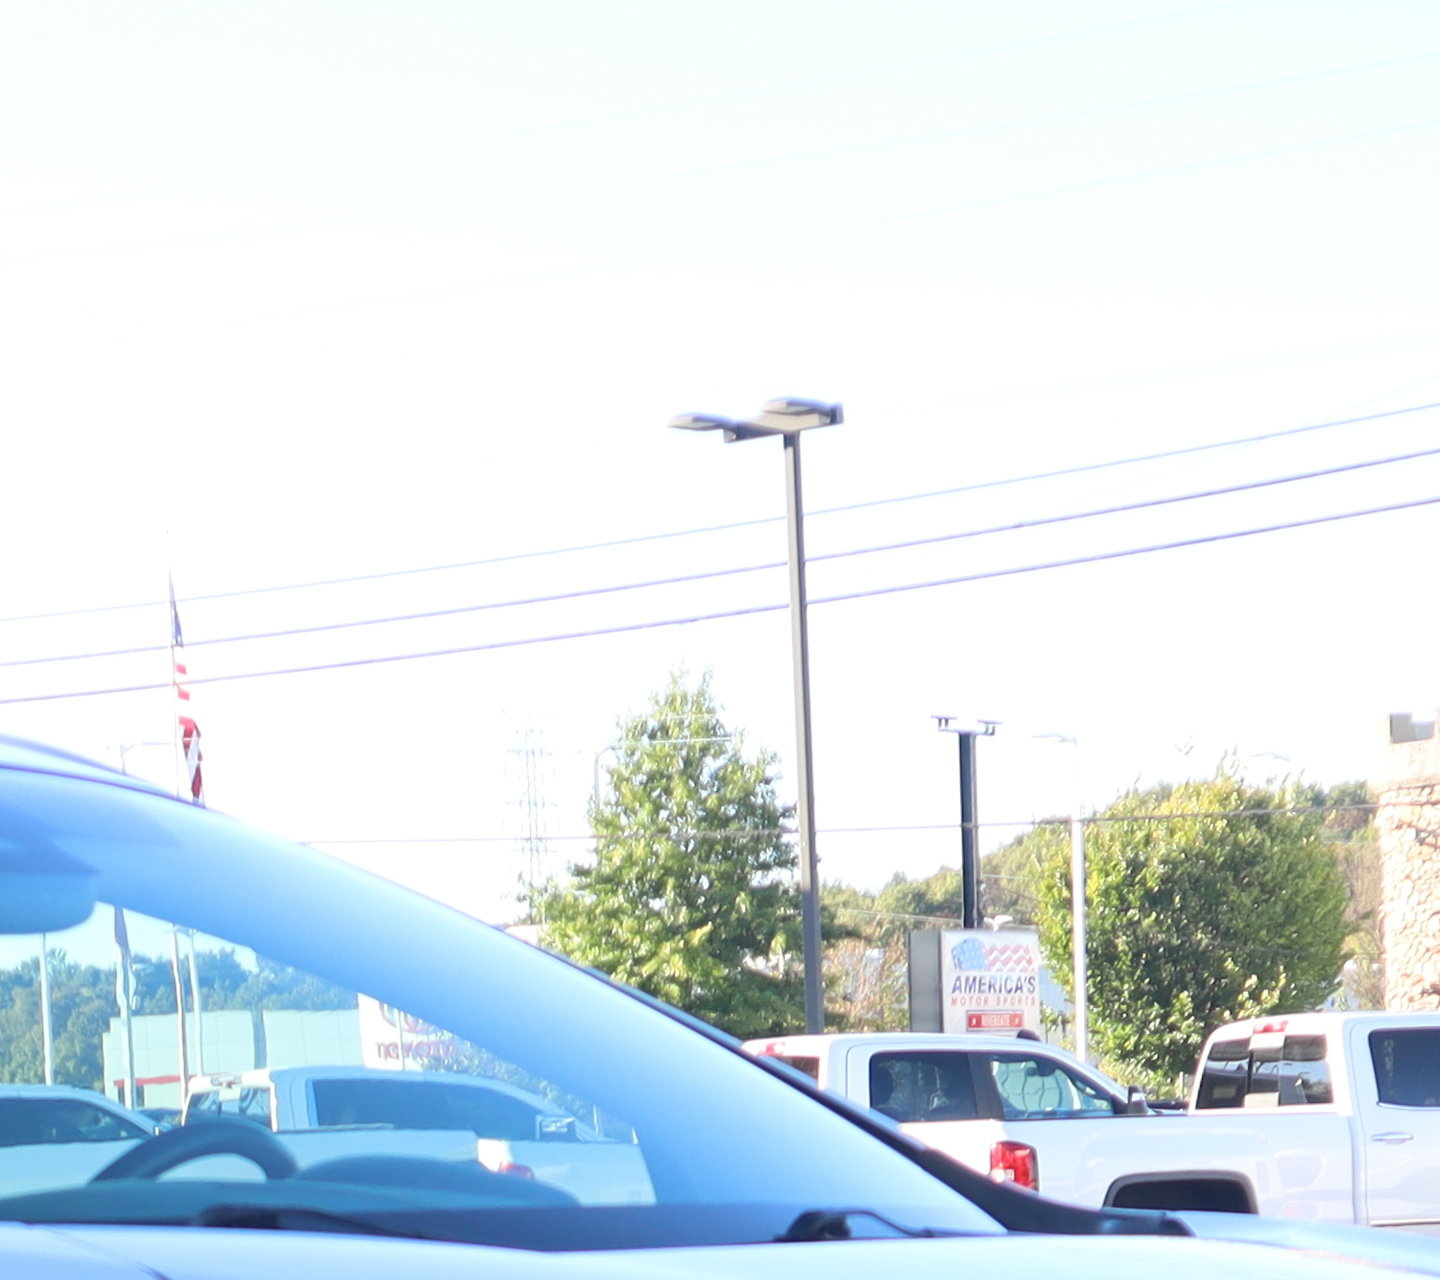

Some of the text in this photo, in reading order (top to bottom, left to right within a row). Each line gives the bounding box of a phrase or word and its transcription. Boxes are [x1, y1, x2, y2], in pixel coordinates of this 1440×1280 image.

[951, 975, 1036, 994] AMERICA'S
[951, 996, 1036, 1006] MOTOR SPORTS
